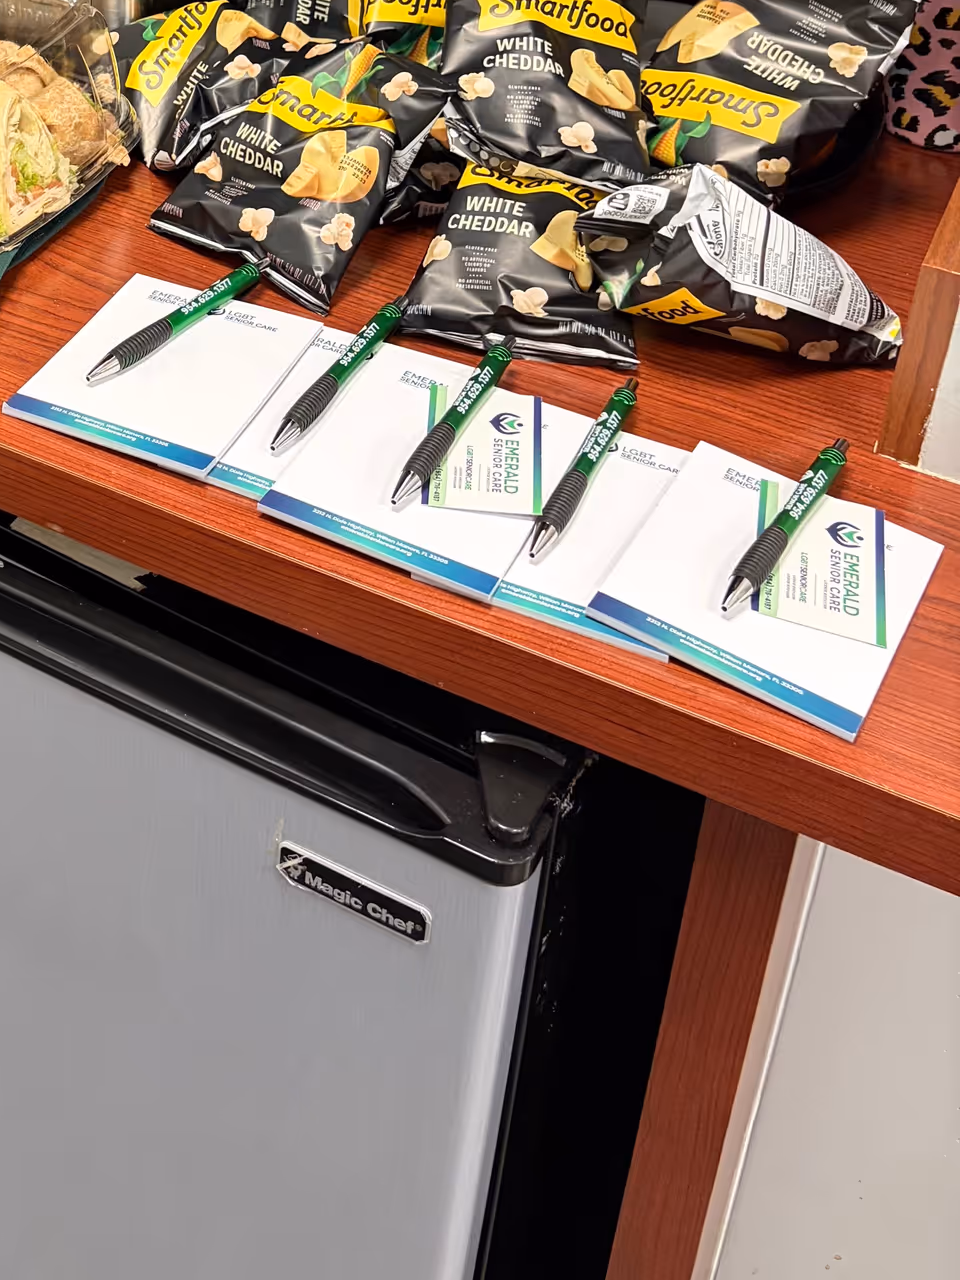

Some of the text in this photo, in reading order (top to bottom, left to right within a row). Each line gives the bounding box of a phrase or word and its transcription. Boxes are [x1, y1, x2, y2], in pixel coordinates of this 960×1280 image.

[496, 37, 554, 57] WHITE
[746, 31, 825, 84] CHEDDAR
[173, 60, 209, 107] WHITE
[483, 54, 565, 78] CHEDDAR
[743, 55, 801, 91] WHITE
[236, 121, 282, 155] WHITE
[220, 138, 284, 178] CHEDDAR
[466, 196, 526, 216] WHITE
[447, 214, 534, 238] CHEDDAR
[180, 278, 232, 315] 954.629.1377
[228, 310, 256, 320] LGBT
[637, 299, 702, 321] food
[224, 314, 278, 332] SENIOR CARE
[339, 322, 380, 367] 954.629.1377
[457, 366, 494, 415] 954.629.1377
[588, 410, 621, 462] 954.629.1377
[622, 446, 656, 460] LGBT
[491, 438, 504, 493] SENIOR CARE
[504, 439, 520, 494] EMERALD
[620, 452, 657, 468] SENIOR
[723, 473, 761, 493] SENIOR
[789, 470, 829, 520] 954.629.1377
[829, 549, 841, 613] SENIOR CARE
[843, 552, 860, 617] EMERALD
[305, 871, 415, 935] Magic Chef
